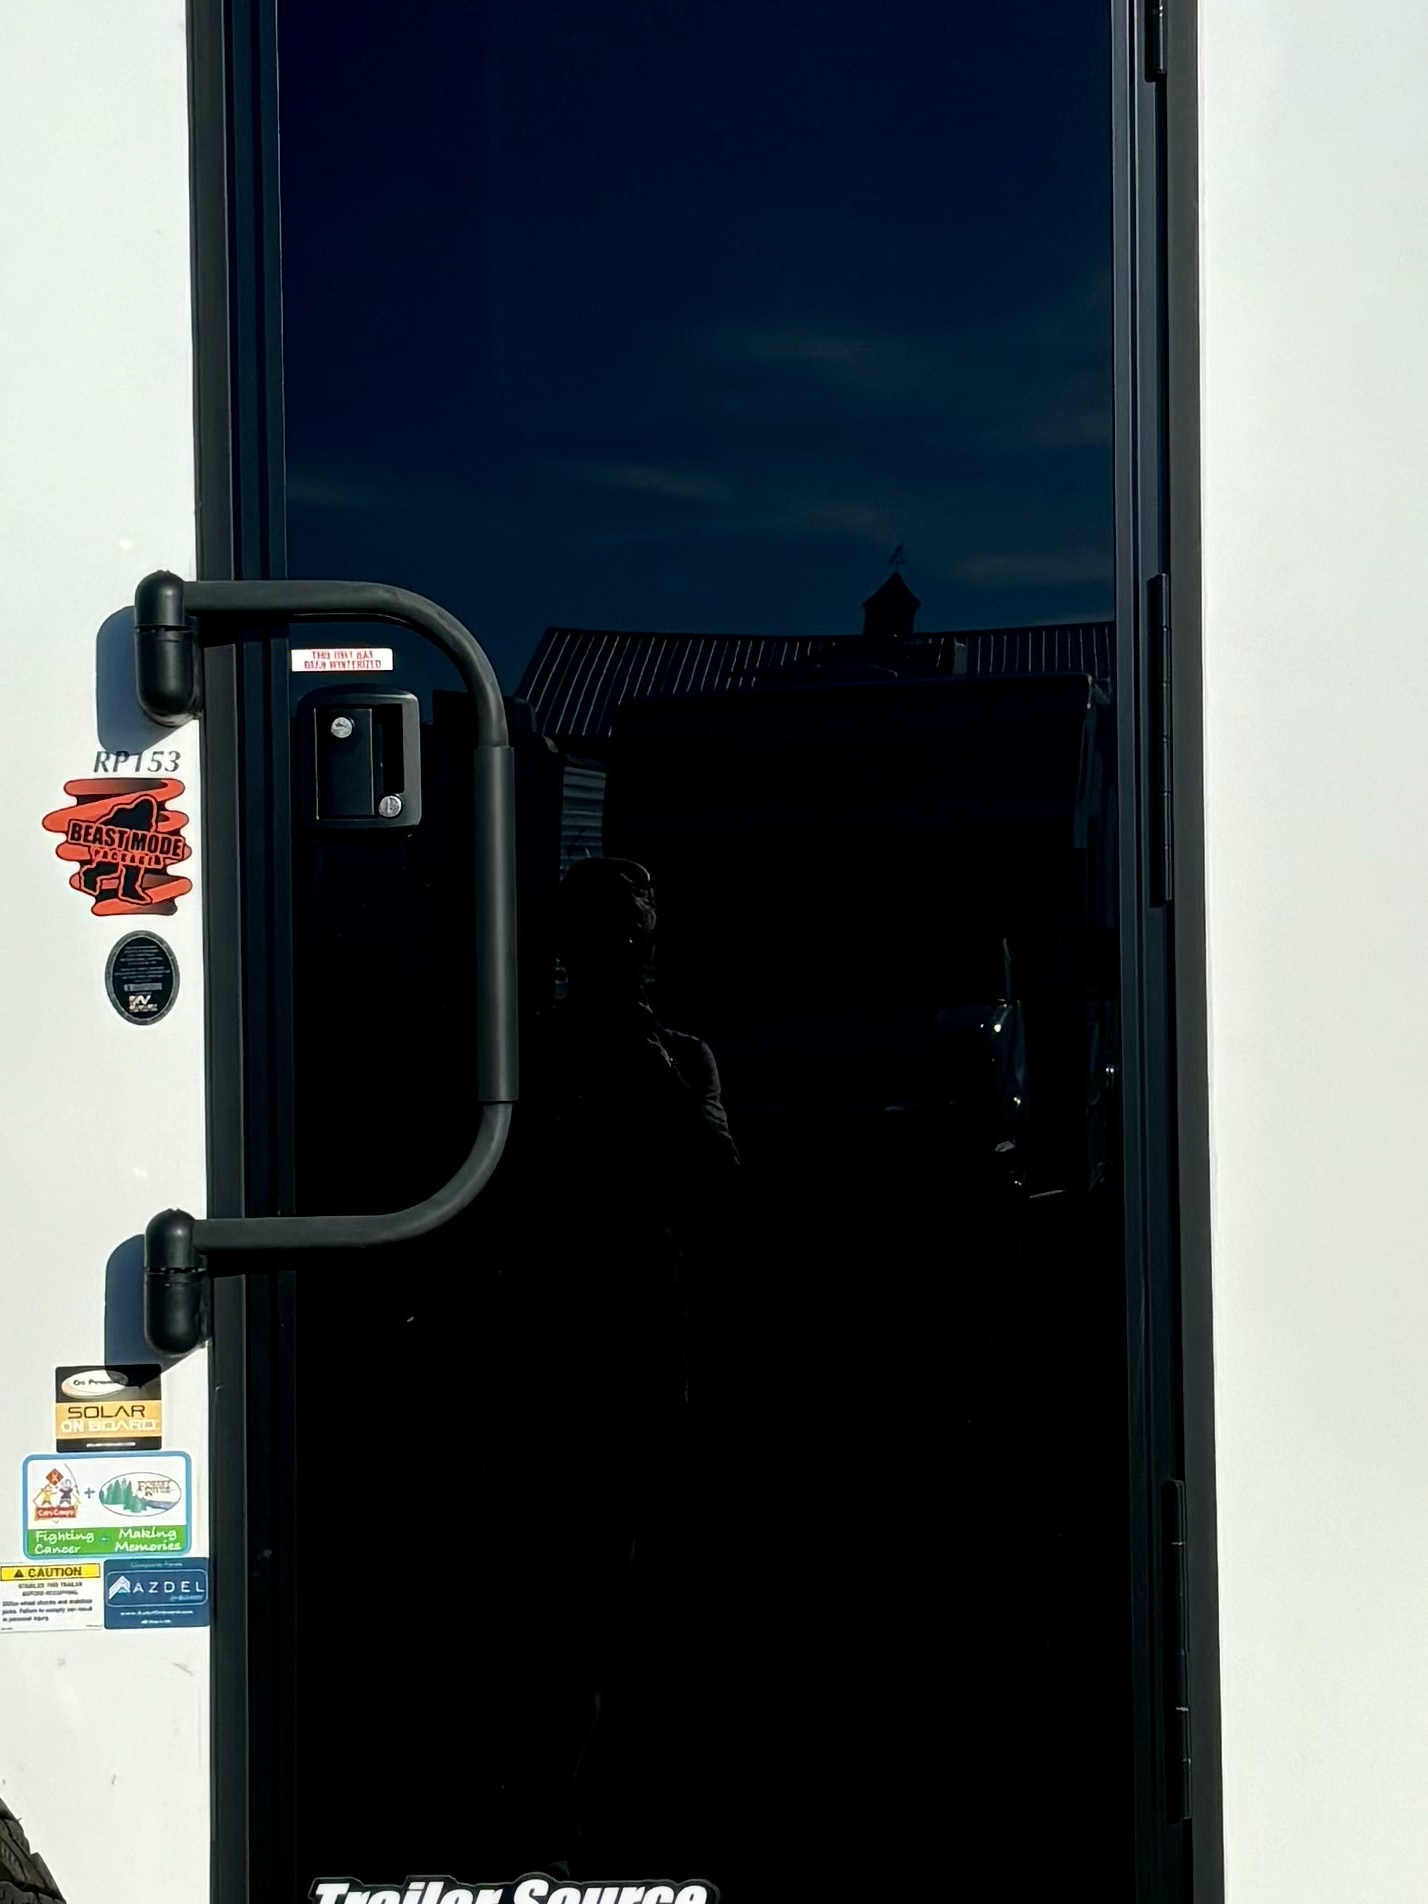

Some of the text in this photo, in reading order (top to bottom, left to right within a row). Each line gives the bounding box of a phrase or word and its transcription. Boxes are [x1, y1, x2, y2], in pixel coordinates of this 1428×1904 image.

[93, 750, 182, 774] RP153
[70, 822, 183, 858] BEAST MODE
[67, 1404, 146, 1420] SOLAR
[61, 1419, 157, 1433] ON BOARD
[34, 1526, 178, 1544] Fighting Making
[34, 1540, 182, 1555] Cancer Memories
[28, 1566, 82, 1578] CAUTION
[132, 1580, 205, 1594] AZDEL
